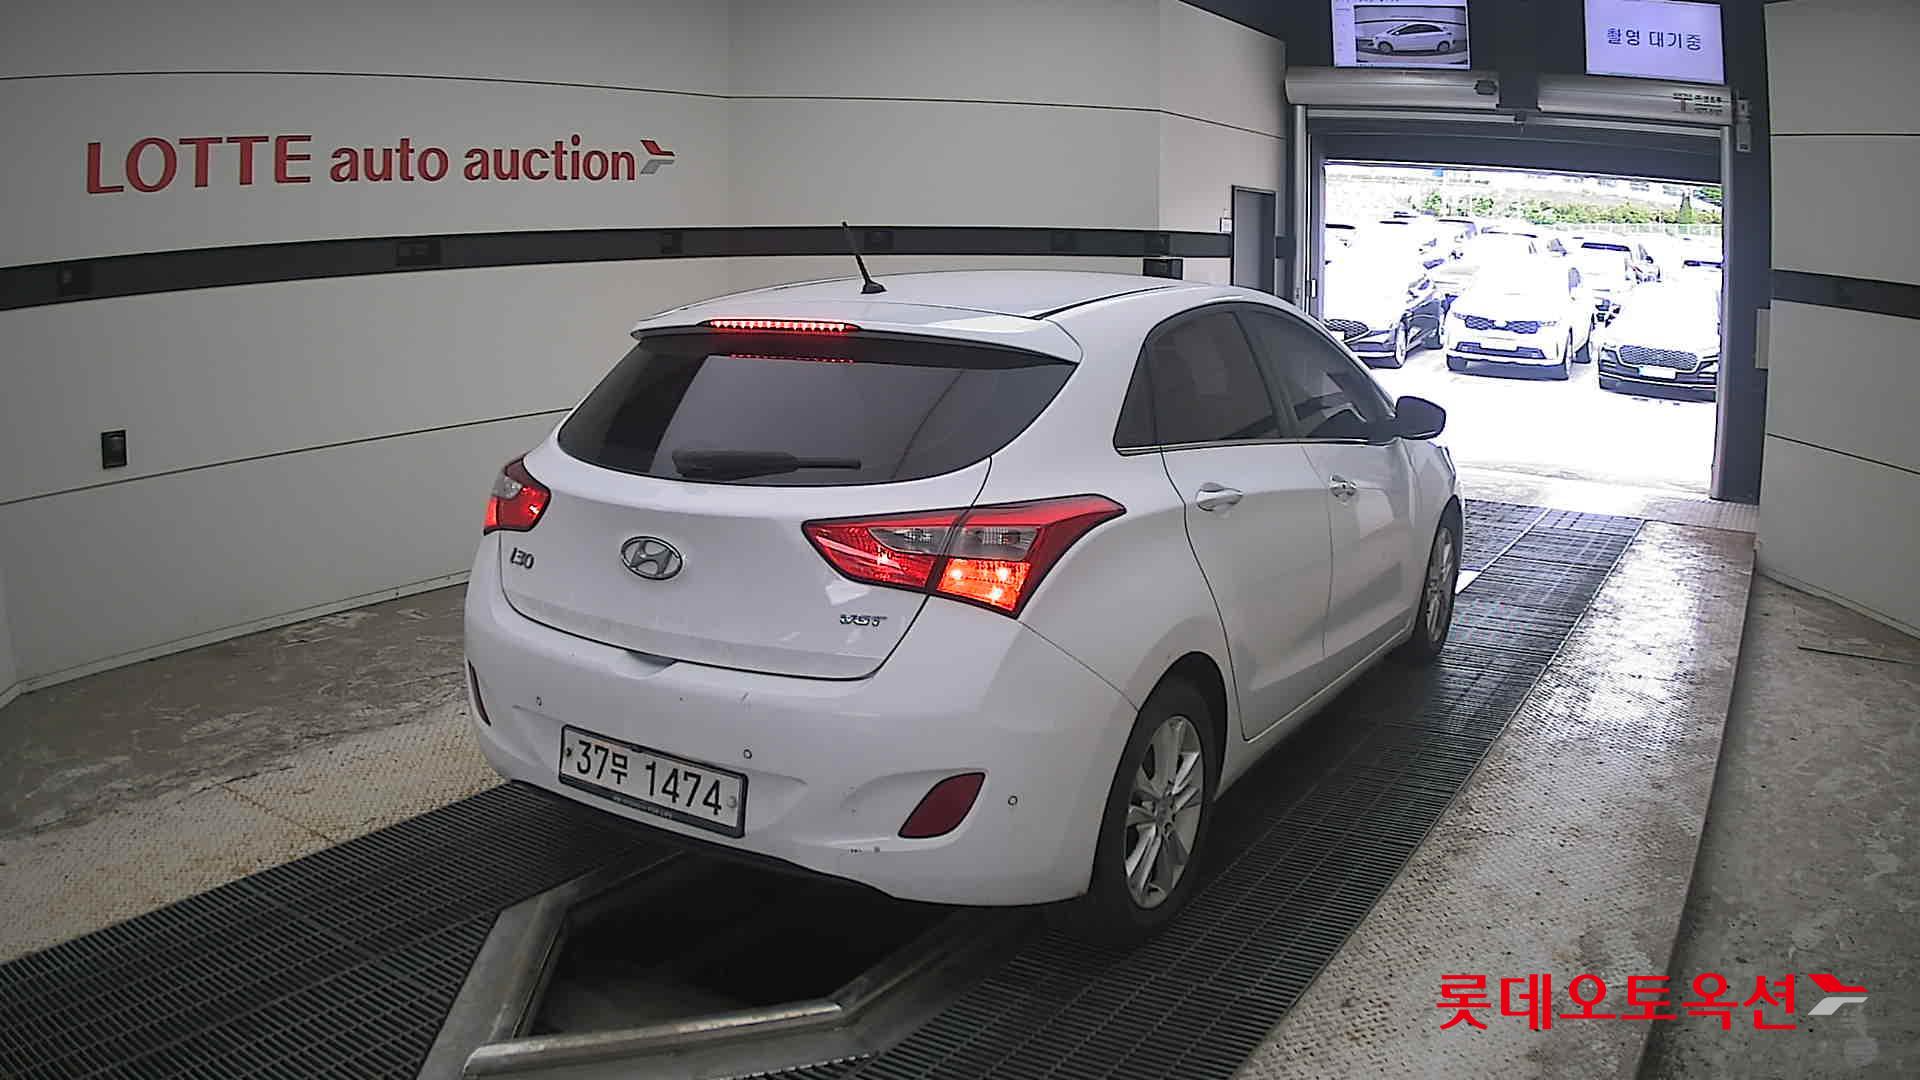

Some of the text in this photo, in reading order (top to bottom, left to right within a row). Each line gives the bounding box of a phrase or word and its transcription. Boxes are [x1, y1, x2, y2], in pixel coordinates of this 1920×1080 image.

[86, 134, 636, 194] LOTTE auto auction
[577, 739, 722, 815] 37무 1474
